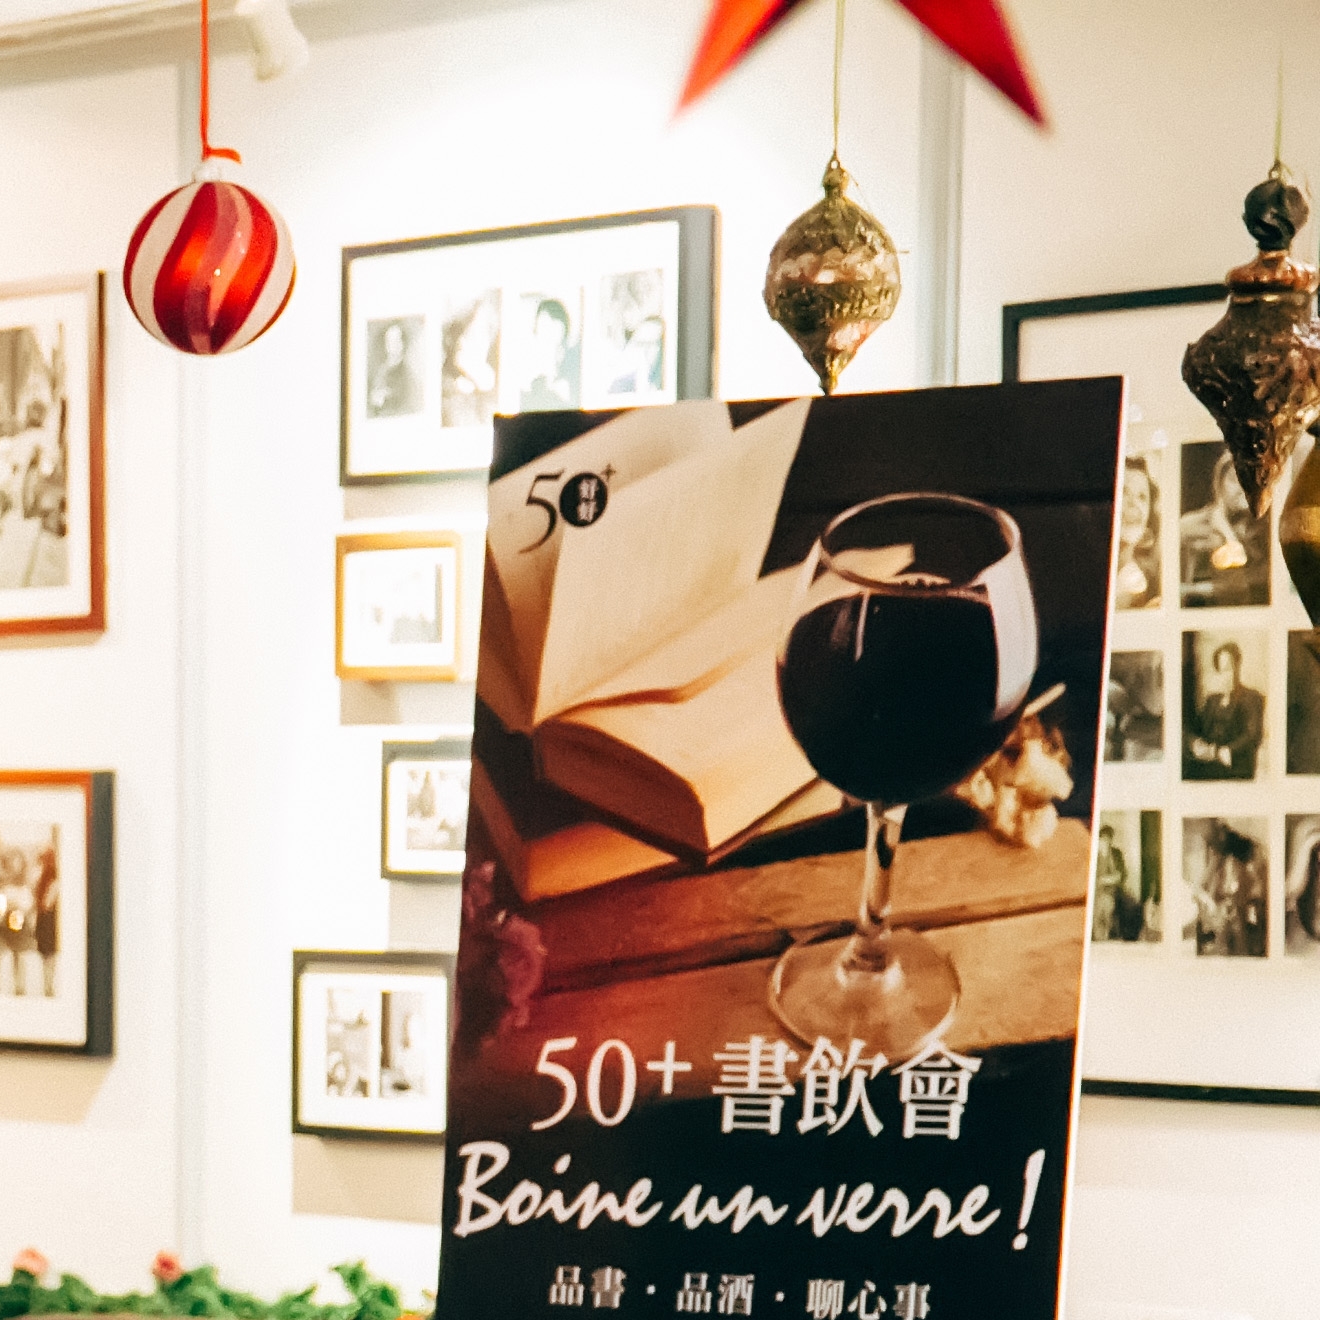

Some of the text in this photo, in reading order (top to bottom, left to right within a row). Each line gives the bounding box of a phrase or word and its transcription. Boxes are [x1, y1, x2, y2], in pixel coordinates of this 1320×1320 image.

[531, 1034, 982, 1141] 50+ 書飲會
[669, 1183, 789, 1234] un
